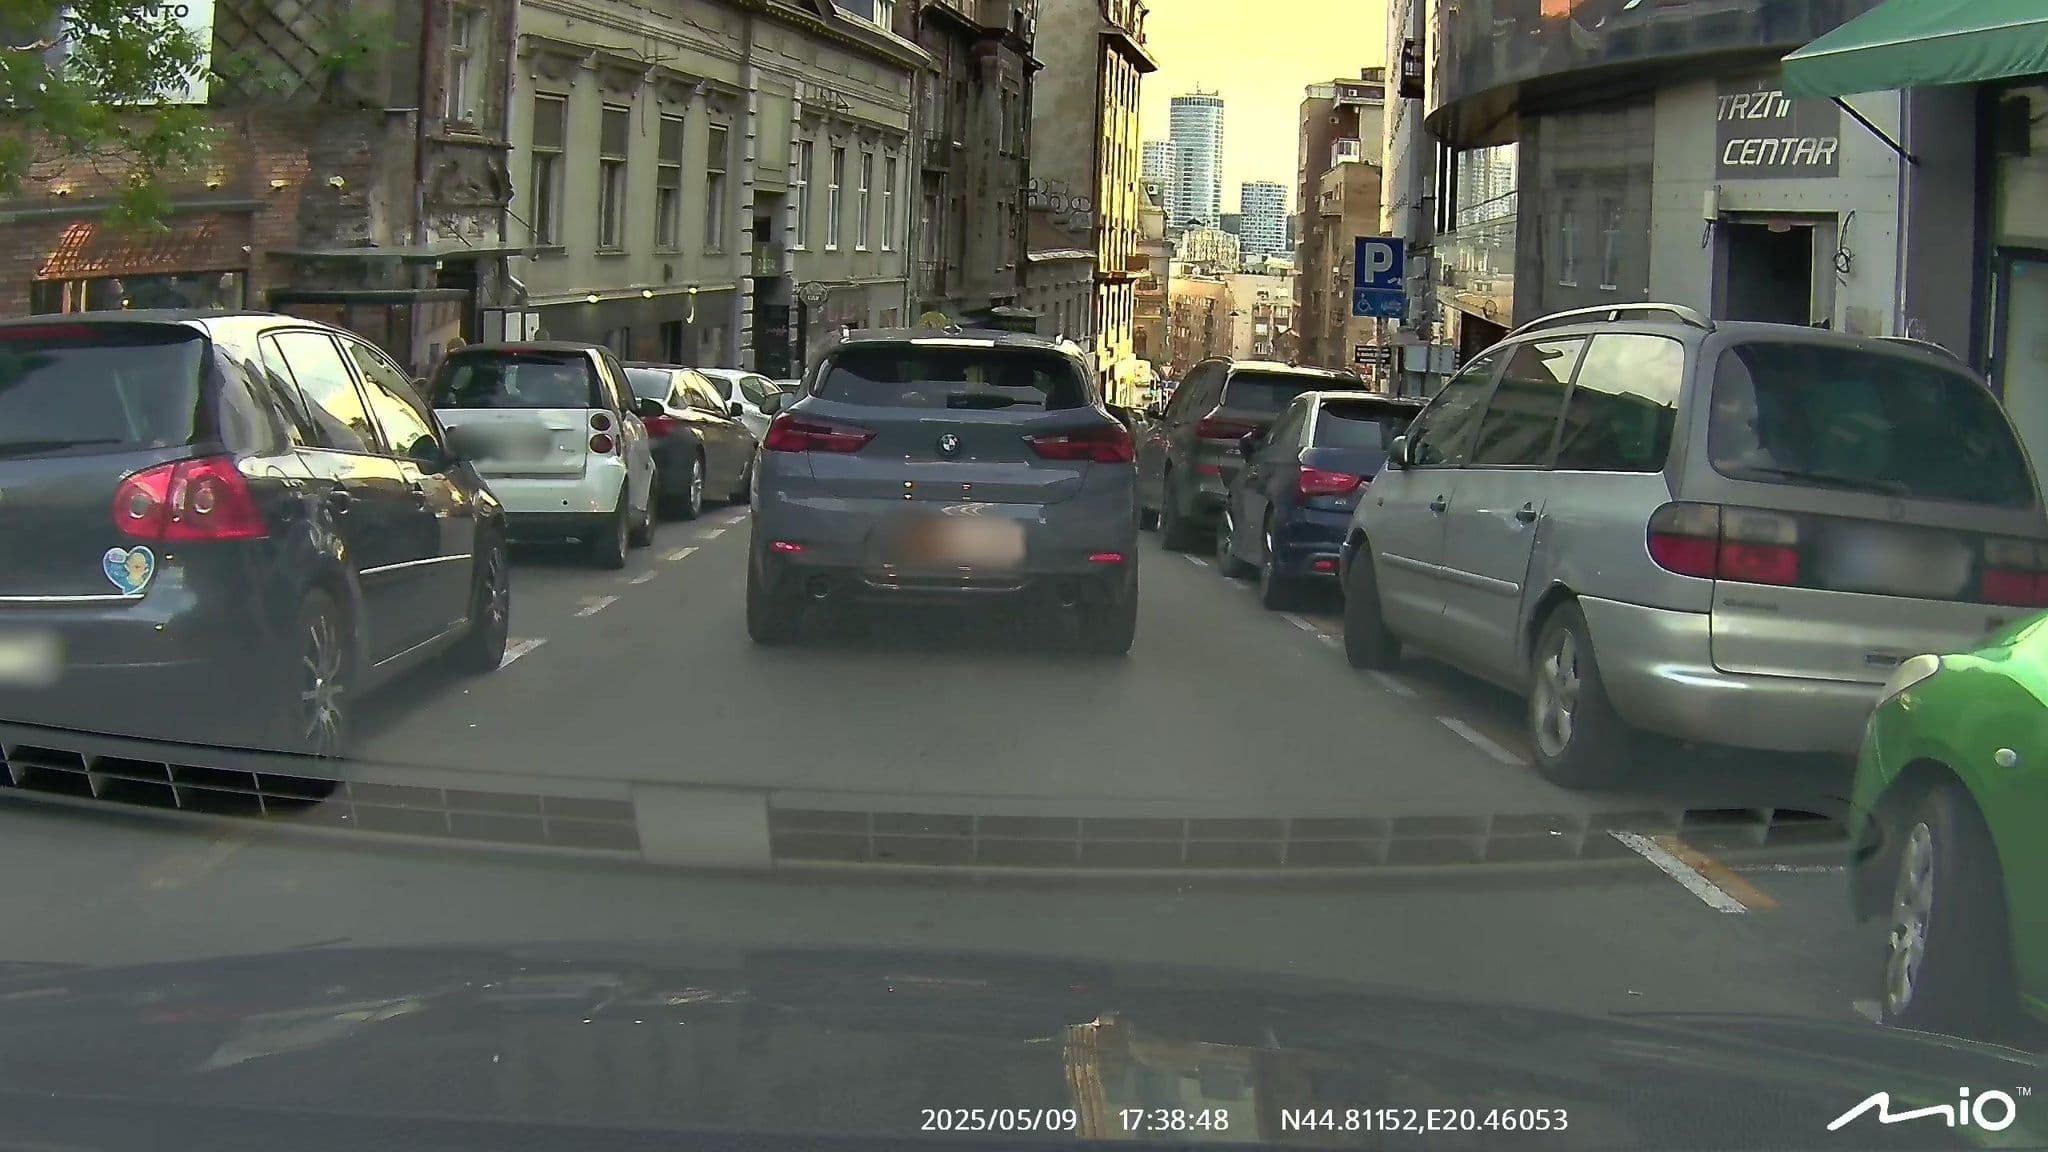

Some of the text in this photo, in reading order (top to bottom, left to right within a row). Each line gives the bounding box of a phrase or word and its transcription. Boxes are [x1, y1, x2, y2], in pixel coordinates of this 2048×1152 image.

[130, 4, 189, 18] ENTO
[1723, 137, 1838, 166] CENTAR
[1364, 242, 1393, 283] P
